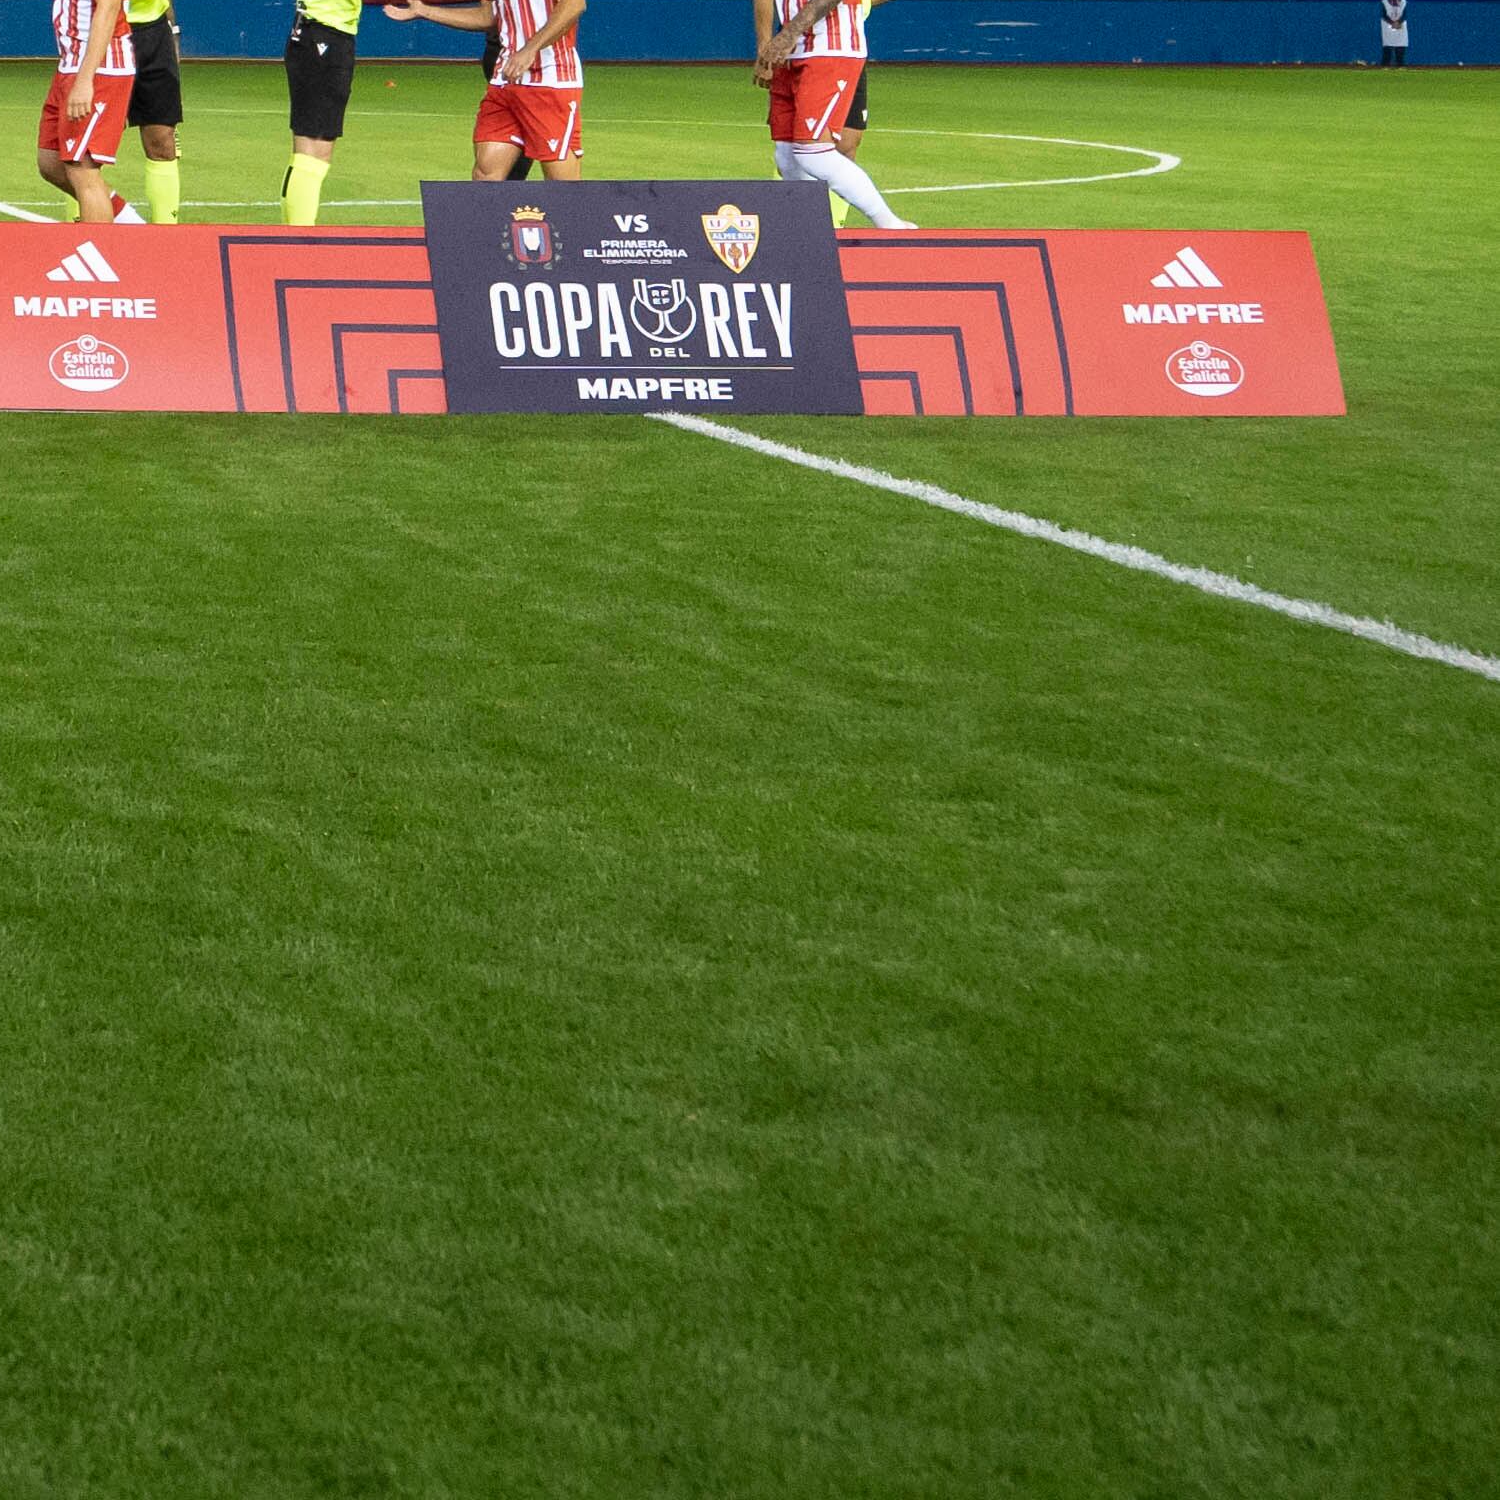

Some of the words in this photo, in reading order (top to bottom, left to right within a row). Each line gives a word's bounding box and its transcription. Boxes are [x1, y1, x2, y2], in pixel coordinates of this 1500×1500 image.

[612, 214, 650, 233] VS
[600, 239, 669, 249] PRIMERA
[583, 249, 689, 258] ELIMINATORIA
[651, 289, 670, 297] RF
[13, 295, 158, 320] MAPFRE
[1123, 301, 1265, 324] MAPFRE
[488, 282, 634, 359] COPA
[648, 346, 691, 358] DEL
[703, 282, 794, 358] REY
[61, 348, 115, 367] Estrella
[1178, 357, 1231, 373] Estrella
[62, 364, 114, 380] Galicia
[1180, 370, 1231, 385] Galicia
[577, 376, 735, 401] MAPFRE
